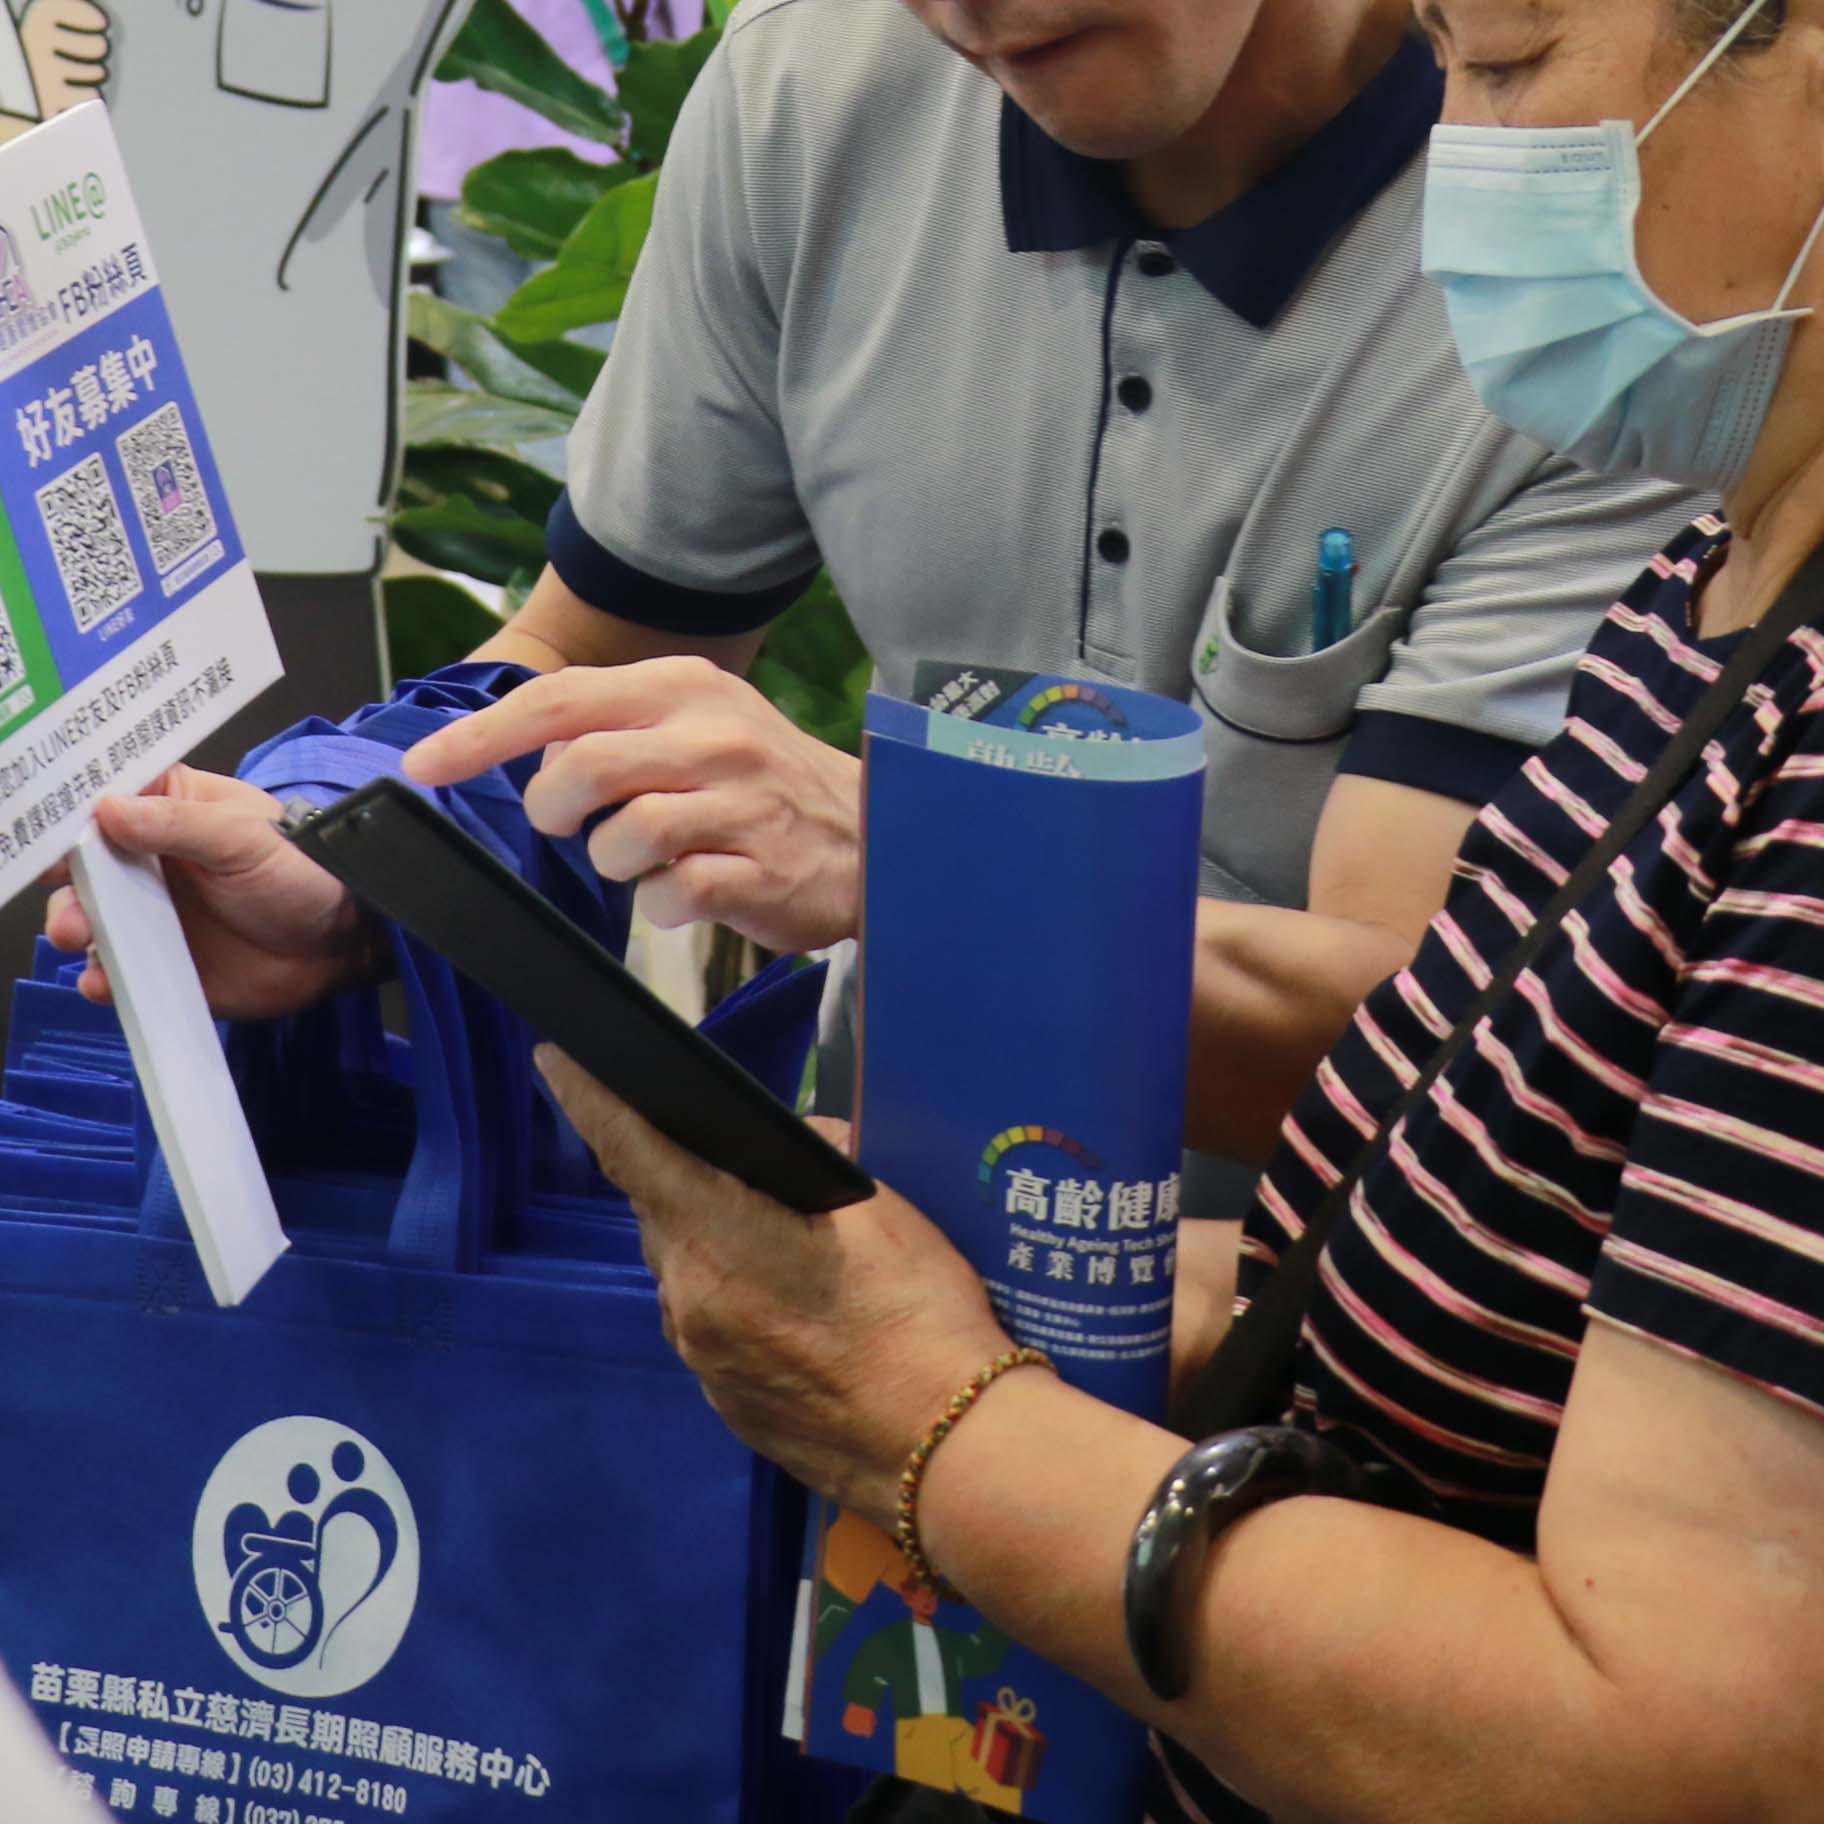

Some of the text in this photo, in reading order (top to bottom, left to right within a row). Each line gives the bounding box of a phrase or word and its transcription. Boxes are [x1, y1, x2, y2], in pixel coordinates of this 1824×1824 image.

[31, 172, 104, 240] LINE@
[59, 242, 148, 324] FB粉絲頁
[16, 334, 158, 468] 好友募集中
[29, 1661, 552, 1798] 苗栗縣私立慈濟長期照顧服務中心
